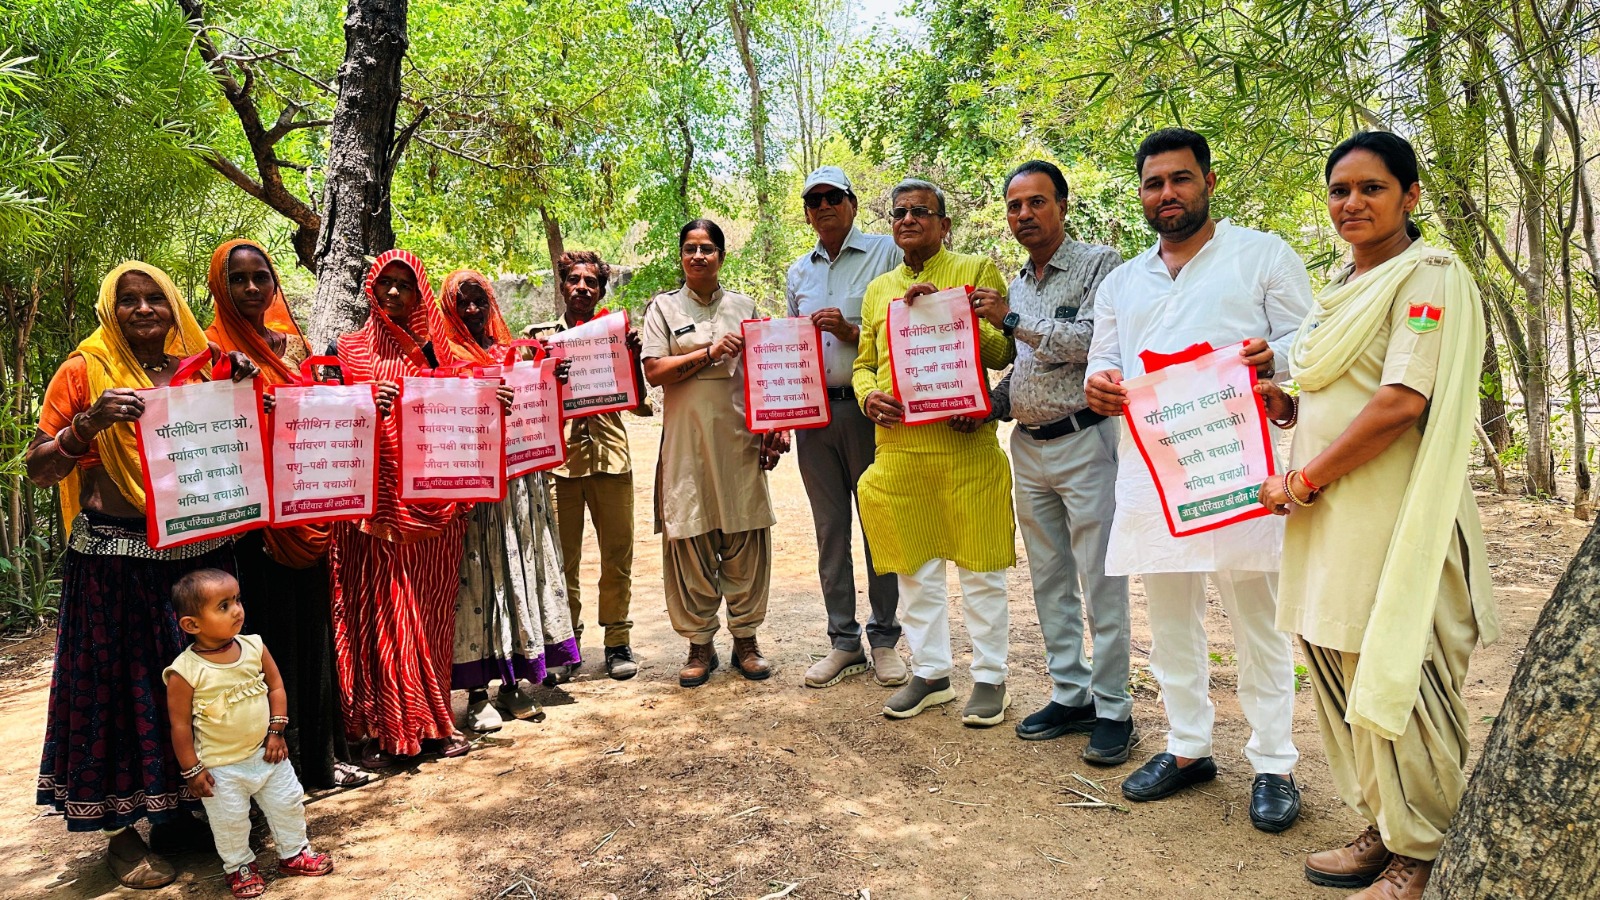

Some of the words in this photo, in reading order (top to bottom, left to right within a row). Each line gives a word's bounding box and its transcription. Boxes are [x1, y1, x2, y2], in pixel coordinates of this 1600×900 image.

[900, 324, 936, 337] पॉलीथिन
[939, 318, 968, 334] हटाओ,
[753, 343, 782, 354] पॉलीथिन
[905, 345, 936, 356] पर्यावरण
[757, 361, 782, 370] पर्यावरण
[913, 382, 932, 392] जीवन
[763, 394, 780, 402] जीवन
[412, 403, 456, 415] पॉलीथिन
[460, 403, 494, 415] हटाओ,
[1144, 401, 1195, 426] पॉलीथिन
[1198, 384, 1242, 409] हटाओ,
[155, 421, 207, 438] पॉलीथिन
[211, 415, 253, 432] हटाओ,
[285, 417, 330, 430] पॉलीथिन
[334, 416, 369, 428] हटाओ,
[419, 423, 454, 433] पर्यावरण
[1158, 428, 1203, 447] पर्यावरण
[1204, 412, 1246, 433] बचाओ।
[288, 439, 326, 451] पर्यावरण
[330, 437, 362, 448] बचाओ।
[167, 447, 207, 462] पर्यावरण
[212, 442, 248, 454] बचाओ।
[1178, 449, 1205, 467] धरती
[1208, 438, 1244, 458] बचाओ।
[332, 457, 364, 468] बचाओ।
[424, 459, 449, 468] जीवन
[178, 469, 203, 485] धरती
[208, 465, 242, 478] बचाओ।
[1184, 474, 1214, 491] भविष्य
[1219, 464, 1249, 482] बचाओ।
[293, 479, 319, 490] जीवन
[324, 478, 356, 489] बचाओ।
[178, 494, 209, 507] भविष्य
[214, 487, 249, 500] बचाओ।
[216, 512, 227, 522] की
